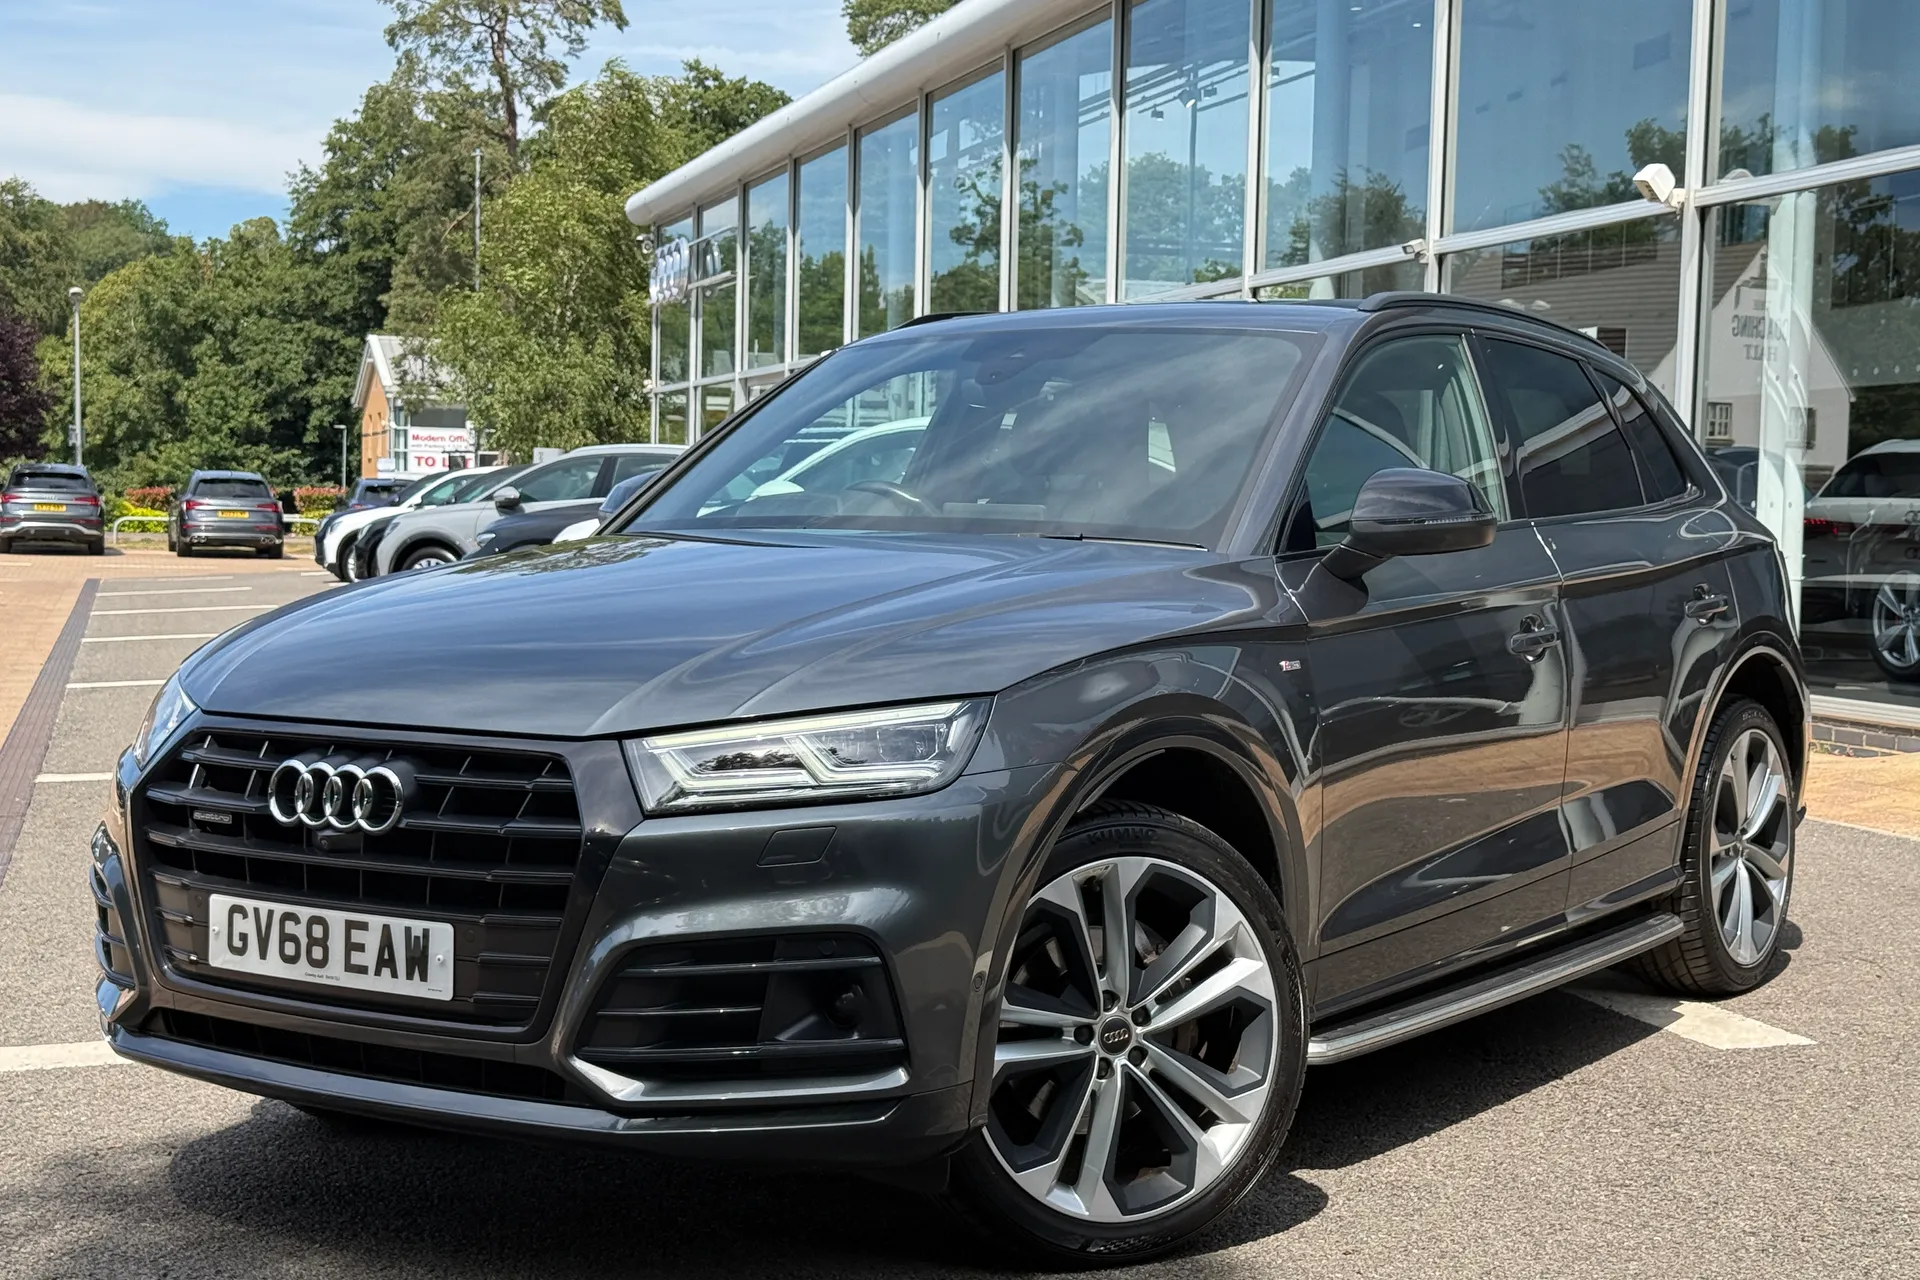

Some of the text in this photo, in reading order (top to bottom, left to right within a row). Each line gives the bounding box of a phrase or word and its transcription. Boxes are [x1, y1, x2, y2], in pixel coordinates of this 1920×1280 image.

[411, 433, 469, 442] Modern Offi
[414, 455, 473, 469] TO LT
[227, 903, 430, 983] GV68 EAW
